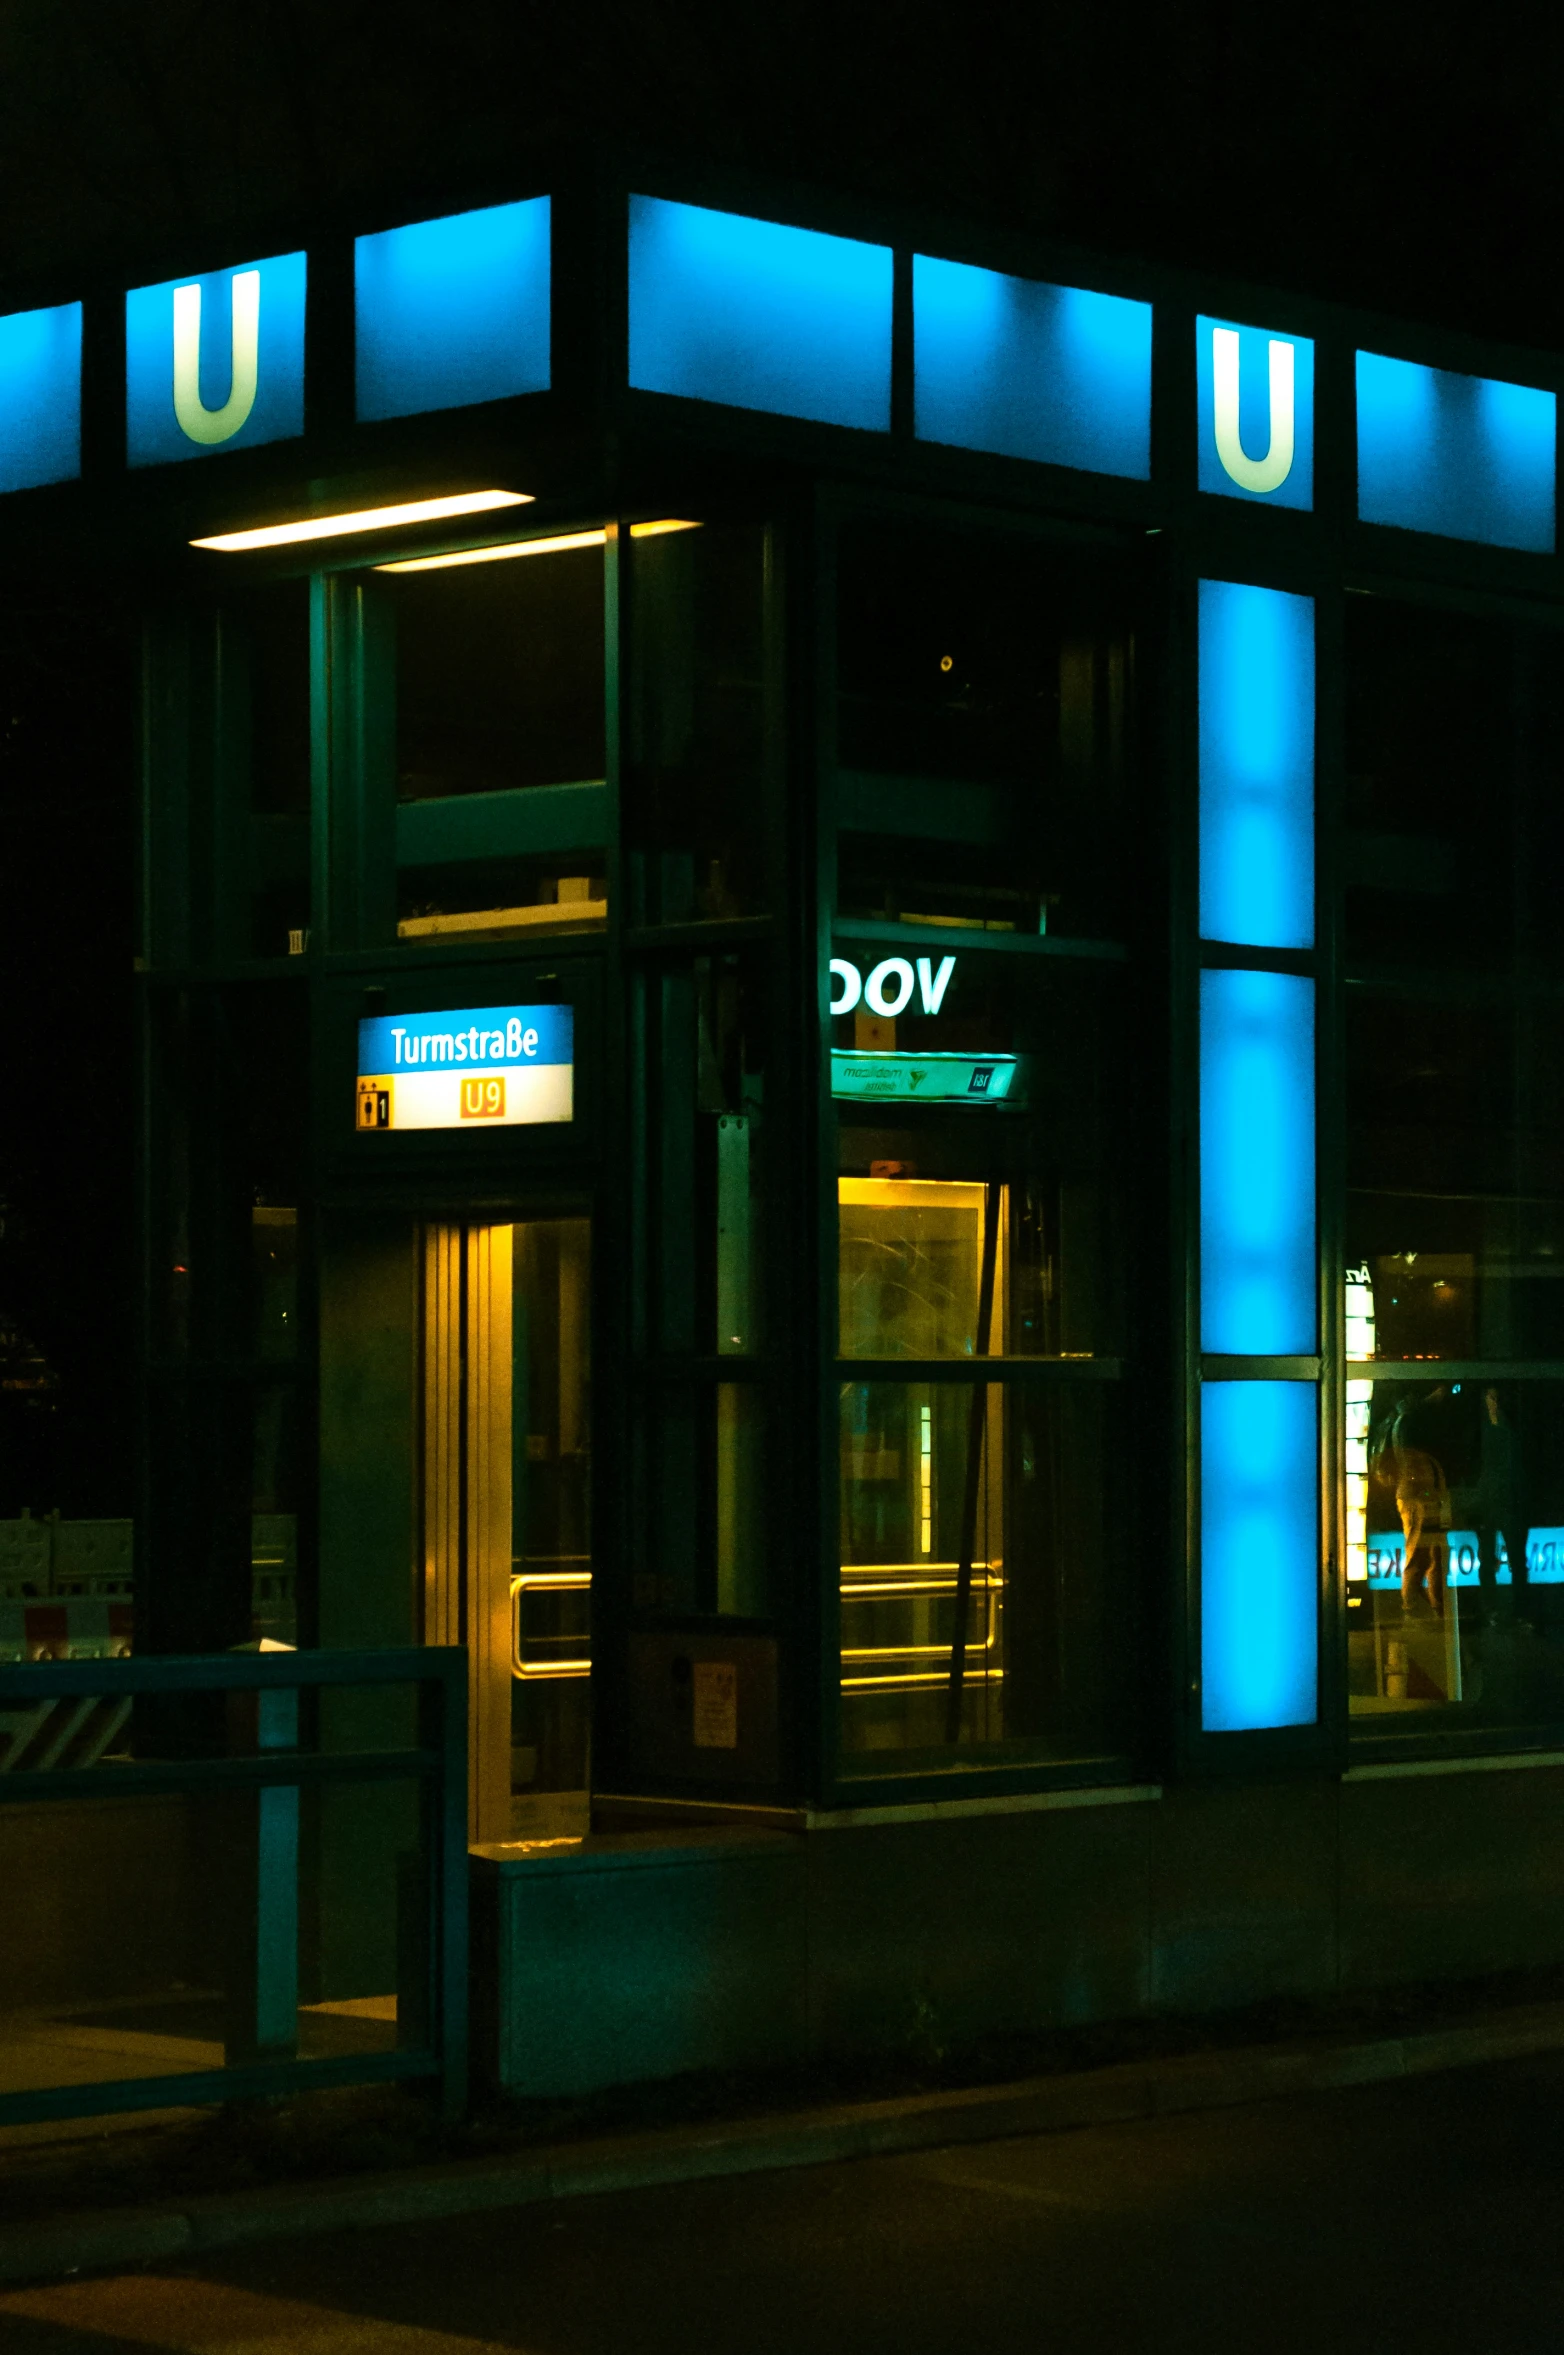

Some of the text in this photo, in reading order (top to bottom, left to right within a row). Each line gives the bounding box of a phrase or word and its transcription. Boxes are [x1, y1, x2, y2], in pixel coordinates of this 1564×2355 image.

[173, 269, 261, 445] U
[1212, 328, 1295, 493] U
[391, 1017, 539, 1064] Turmstraße
[379, 1098, 386, 1120] 1
[465, 1081, 501, 1114] U9
